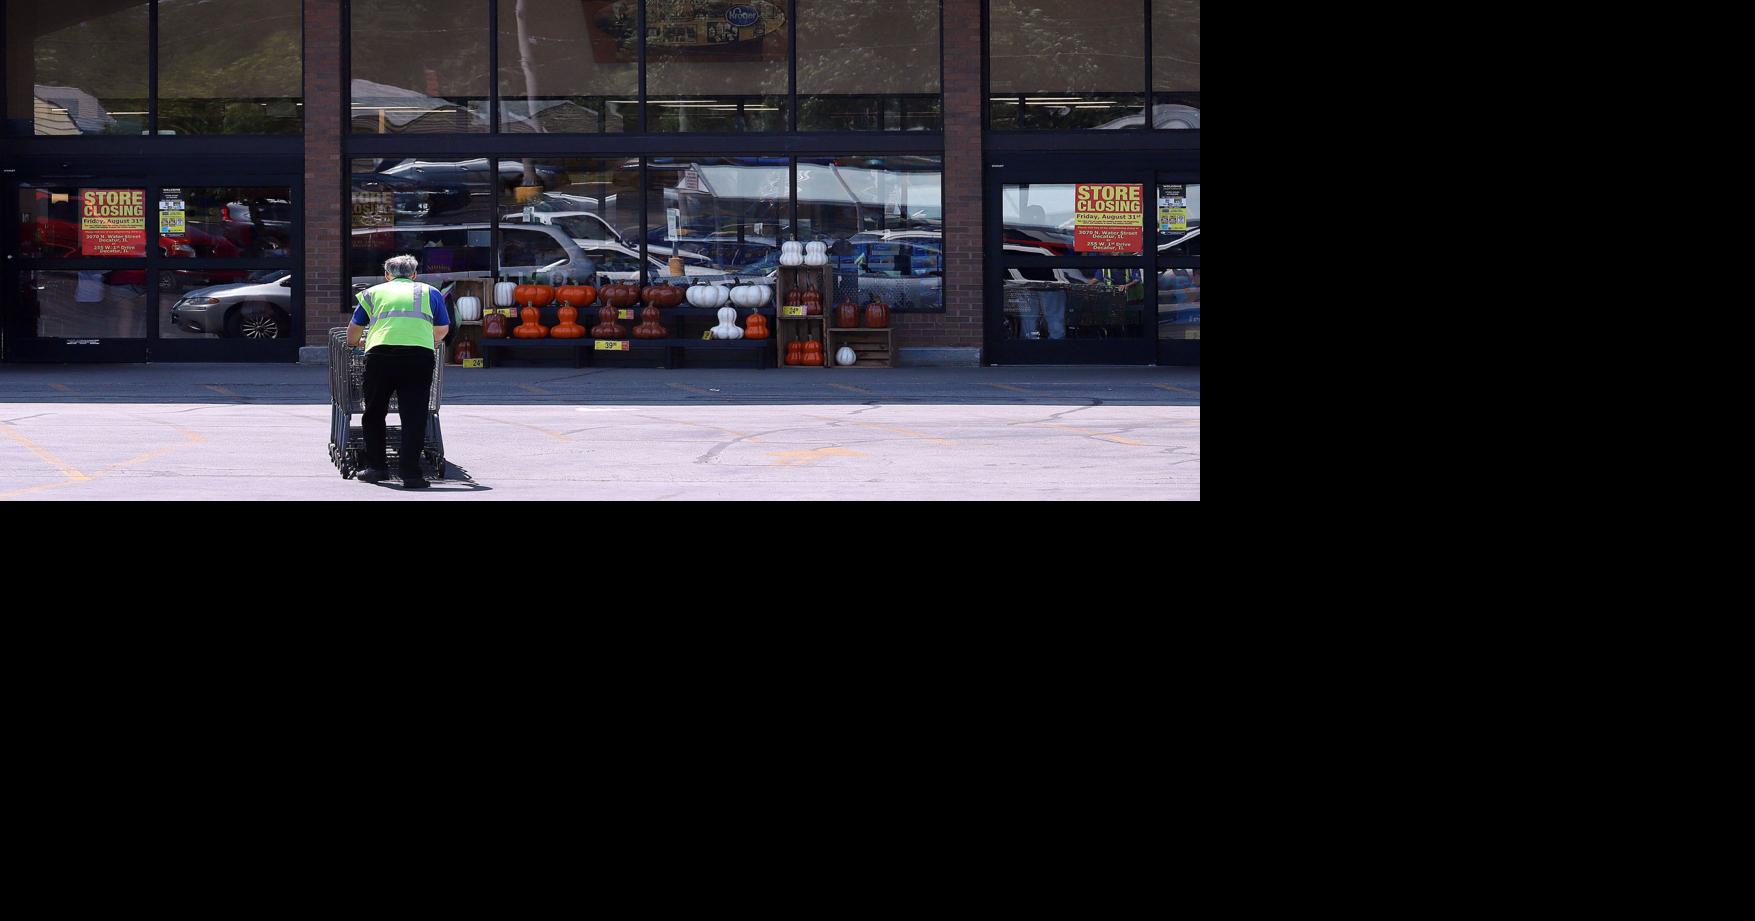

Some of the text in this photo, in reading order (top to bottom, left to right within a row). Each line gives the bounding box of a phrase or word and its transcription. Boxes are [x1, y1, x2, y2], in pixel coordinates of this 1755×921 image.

[729, 7, 756, 20] Kroger
[84, 191, 143, 205] STORE
[1078, 185, 1140, 200] STORE
[84, 205, 143, 216] CLOSING
[1077, 200, 1140, 212] CLOSING
